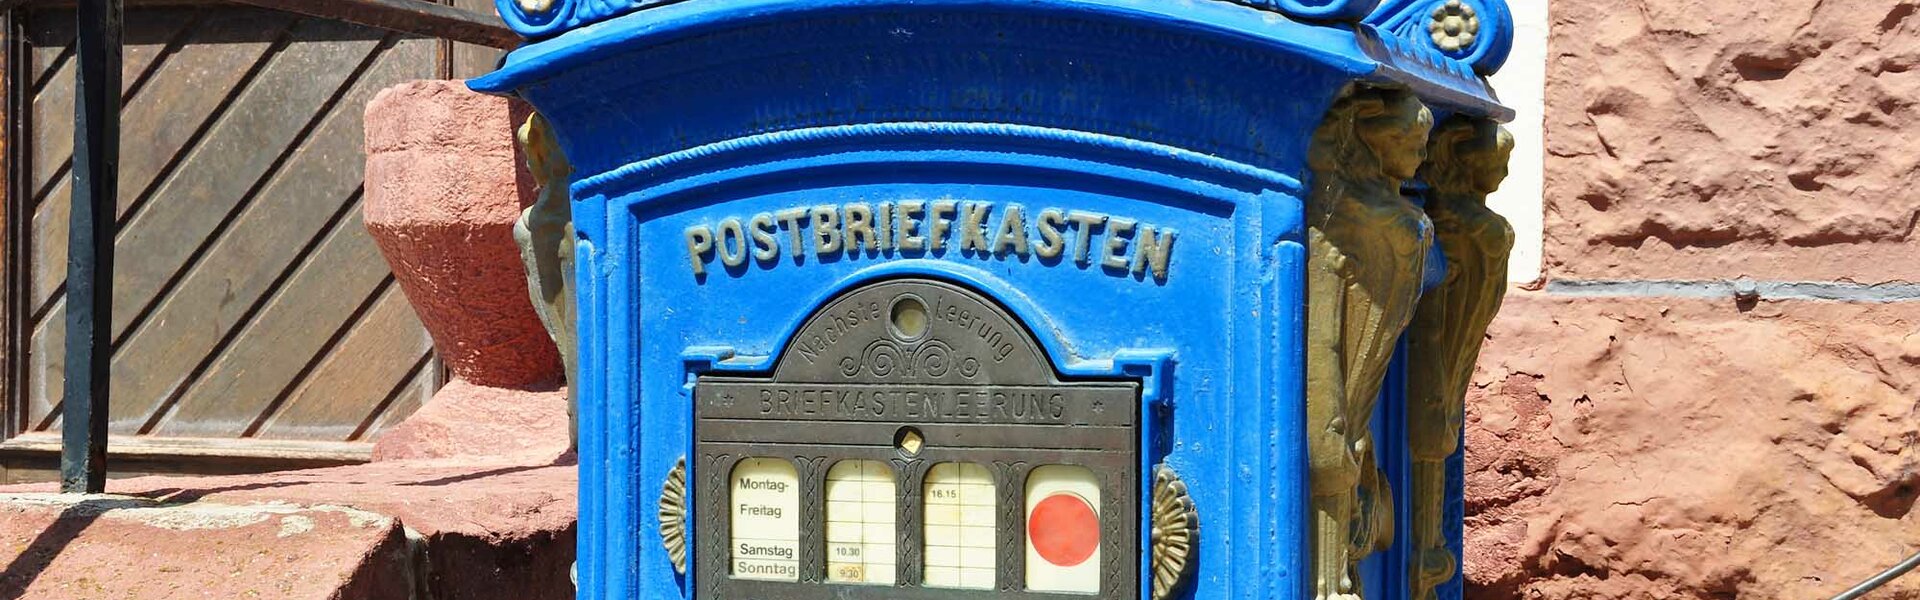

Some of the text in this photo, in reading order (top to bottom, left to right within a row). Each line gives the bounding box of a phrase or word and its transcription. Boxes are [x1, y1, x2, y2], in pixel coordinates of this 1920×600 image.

[684, 201, 1176, 284] POSTBRIEFKASTEN
[758, 388, 1065, 421] BRIEFKASTENLEERUNG
[739, 478, 789, 493] Montag-
[931, 489, 957, 499] 16.15
[739, 503, 782, 519] Freitag
[739, 543, 793, 559] Samstag
[835, 547, 861, 557] 10.30
[737, 561, 796, 577] Sonntag
